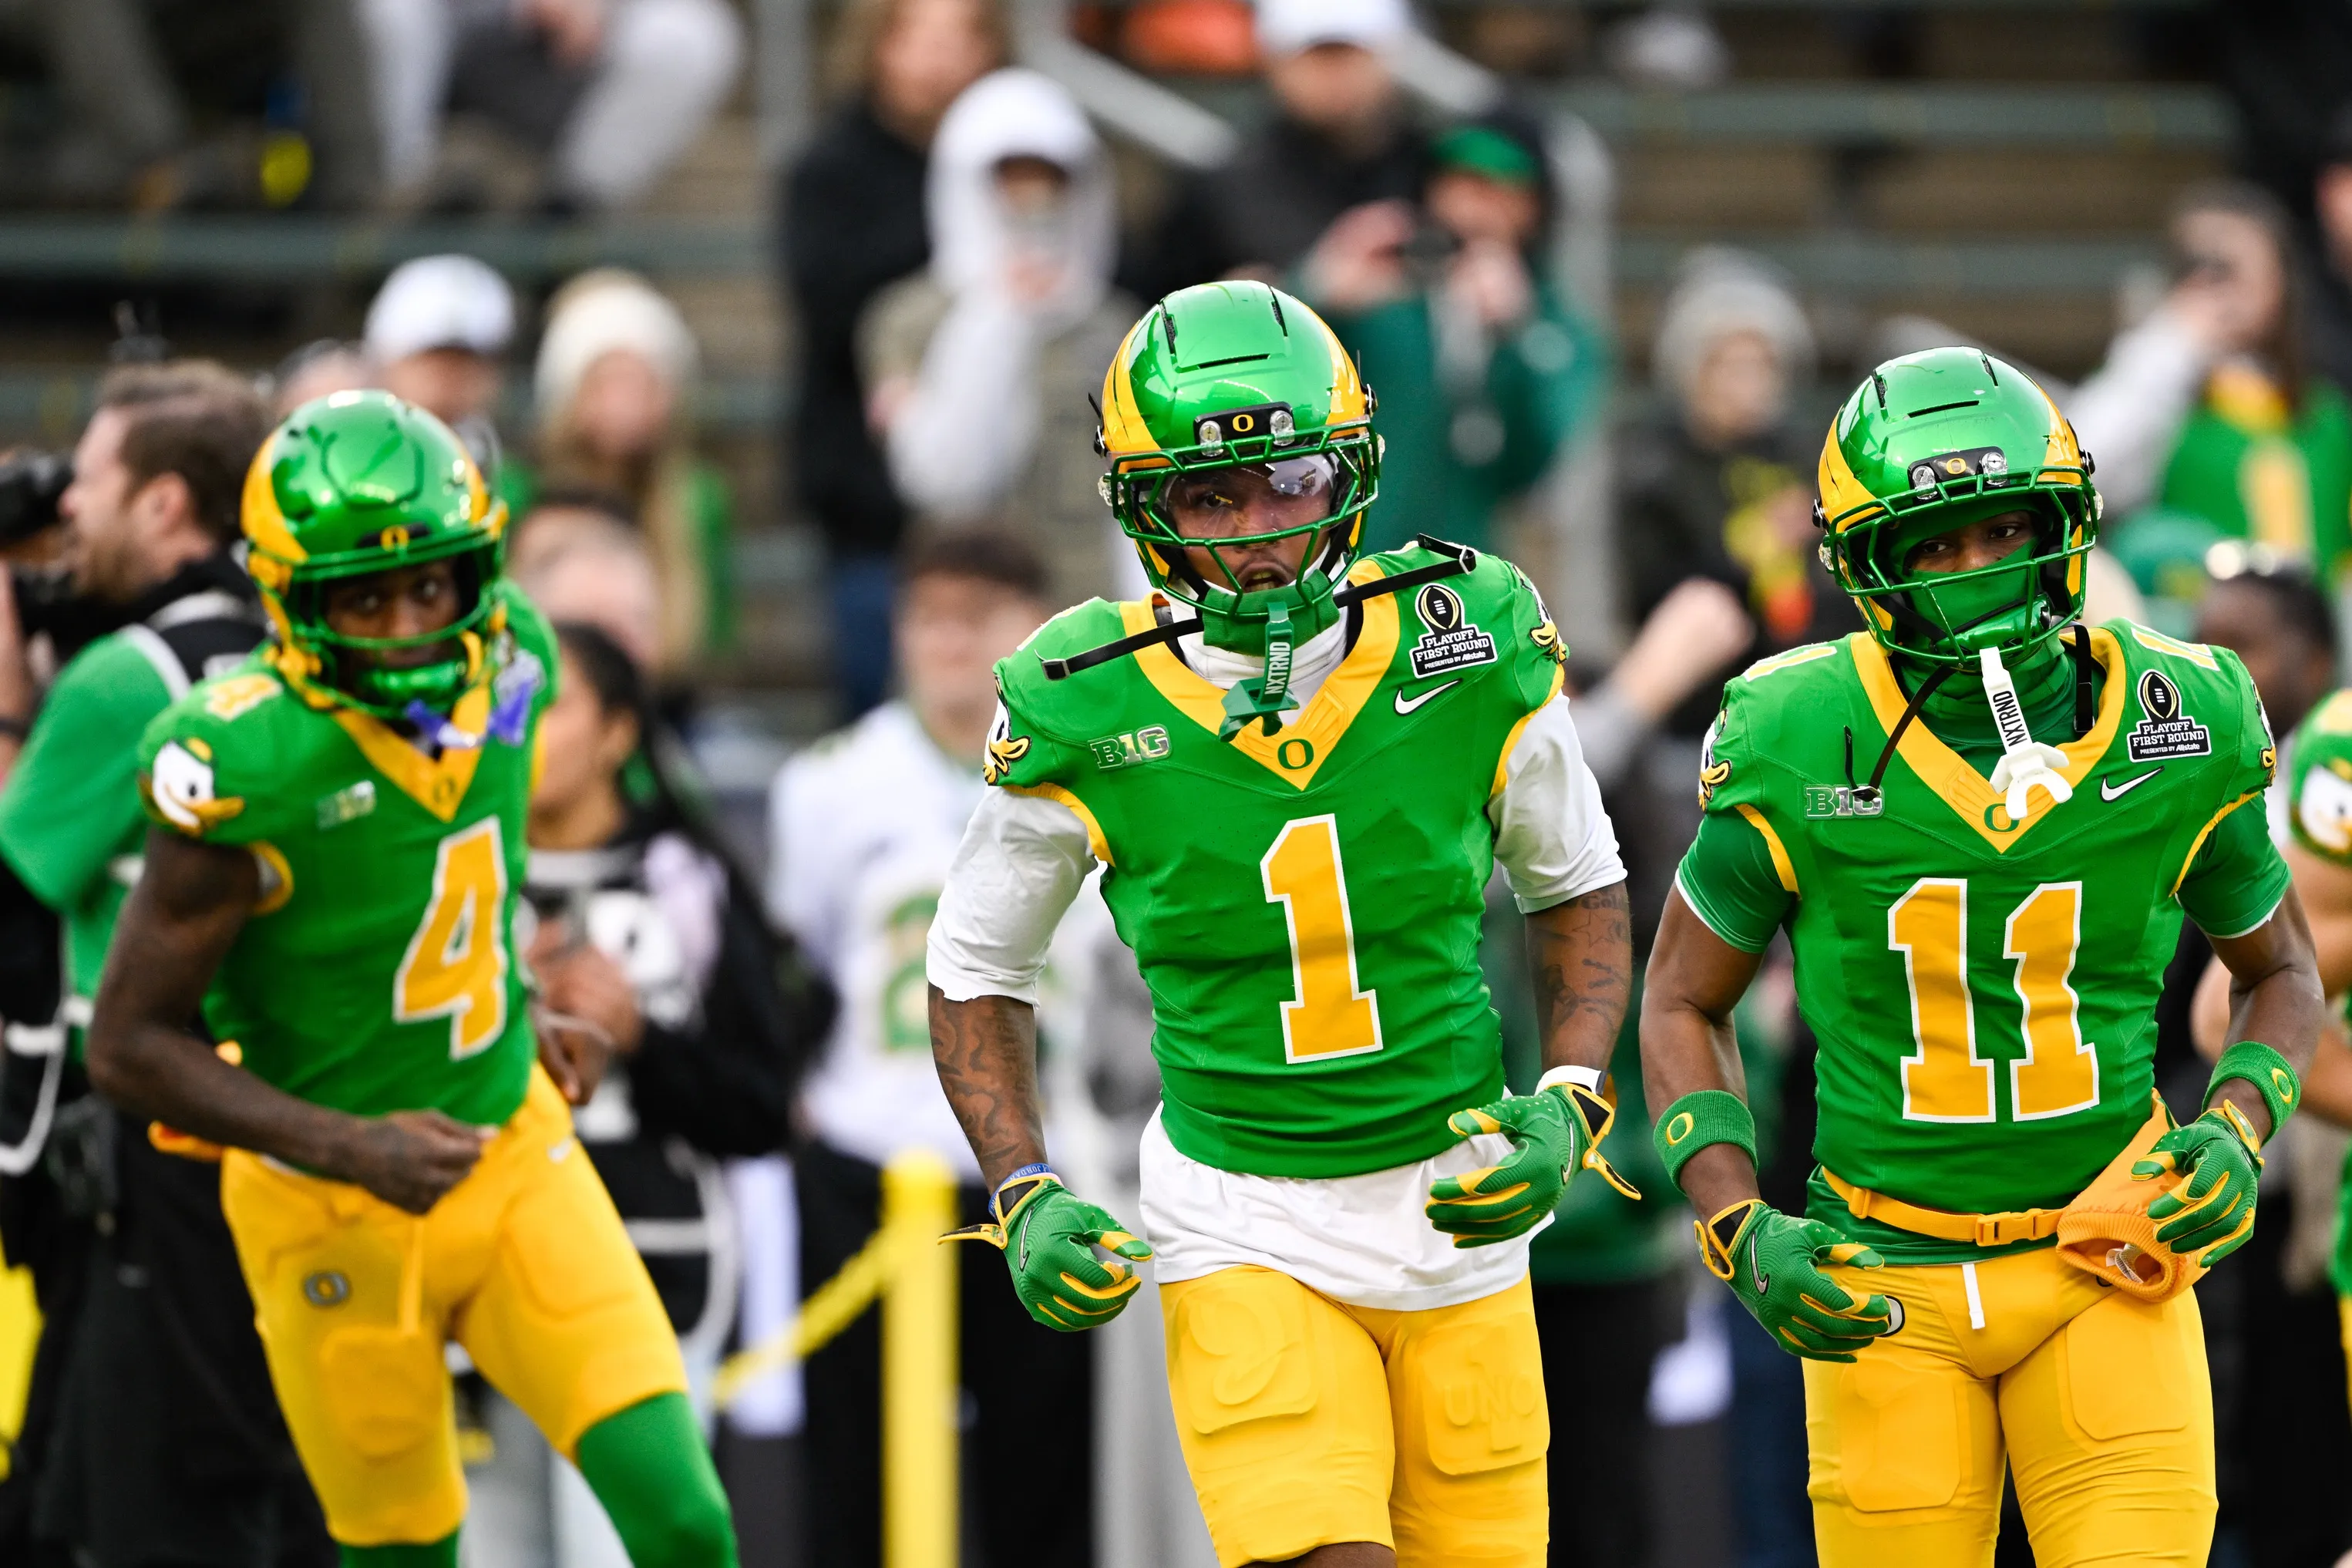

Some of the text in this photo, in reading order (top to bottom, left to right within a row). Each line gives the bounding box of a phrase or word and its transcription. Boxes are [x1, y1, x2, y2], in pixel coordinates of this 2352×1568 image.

[1232, 414, 1254, 432] O
[1946, 458, 1967, 475] O
[1415, 638, 1490, 662] FIRST ROUND
[1425, 629, 1475, 648] PLAYOFF
[1264, 641, 1290, 695] NXTRND
[1424, 658, 1454, 669] PRESENTED
[1462, 651, 1486, 661] Allstate
[1992, 690, 2028, 747] NXTRND
[2142, 721, 2190, 735] PLAYOFF
[2132, 731, 2205, 747] FIRST ROUND
[2140, 746, 2168, 755] PRESENTED
[2175, 742, 2200, 752] Allstate
[1277, 739, 1314, 769] O
[392, 814, 509, 1062] 4
[1260, 813, 1384, 1065] 1
[1888, 877, 2100, 1123] 11
[1666, 1112, 1694, 1146] O
